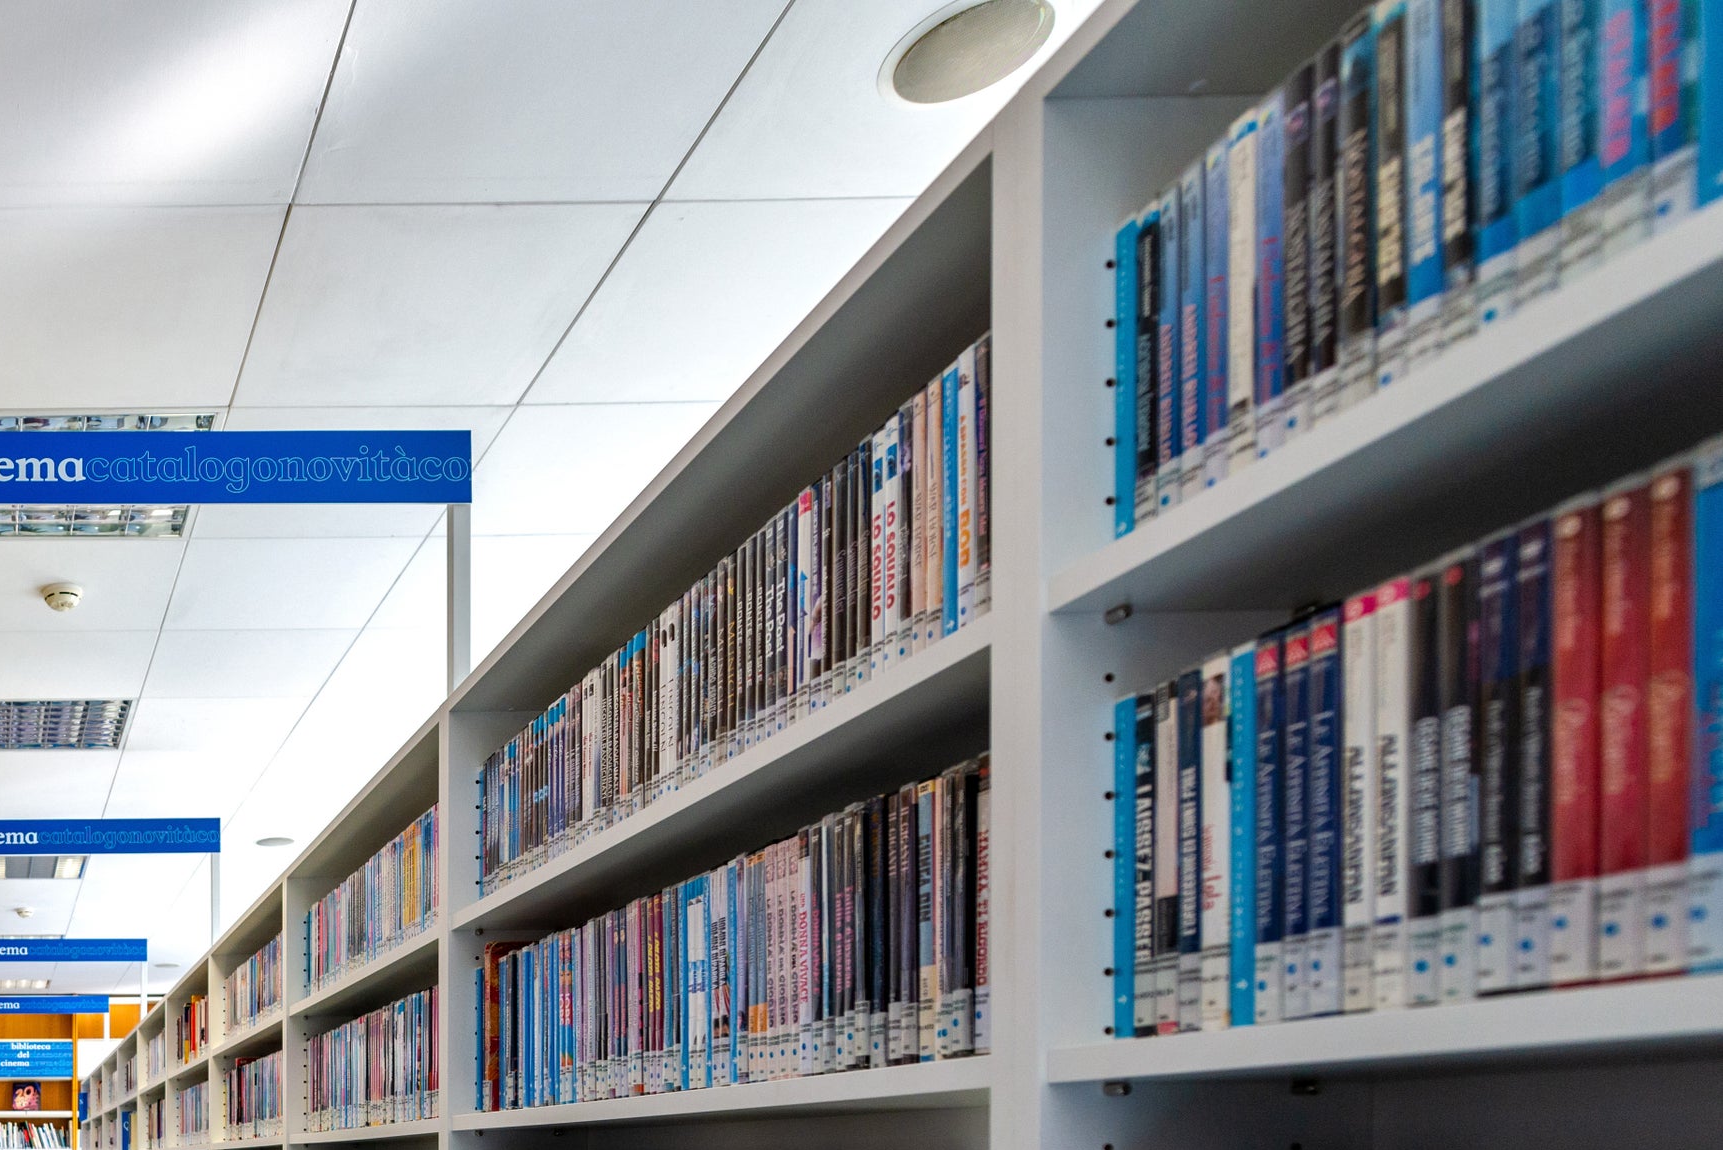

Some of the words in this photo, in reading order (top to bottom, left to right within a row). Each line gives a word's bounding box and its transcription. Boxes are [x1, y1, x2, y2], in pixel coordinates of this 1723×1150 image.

[977, 921, 988, 987] RICORDO
[11, 1042, 51, 1050] biblioteca
[0, 1059, 30, 1067] cinema
